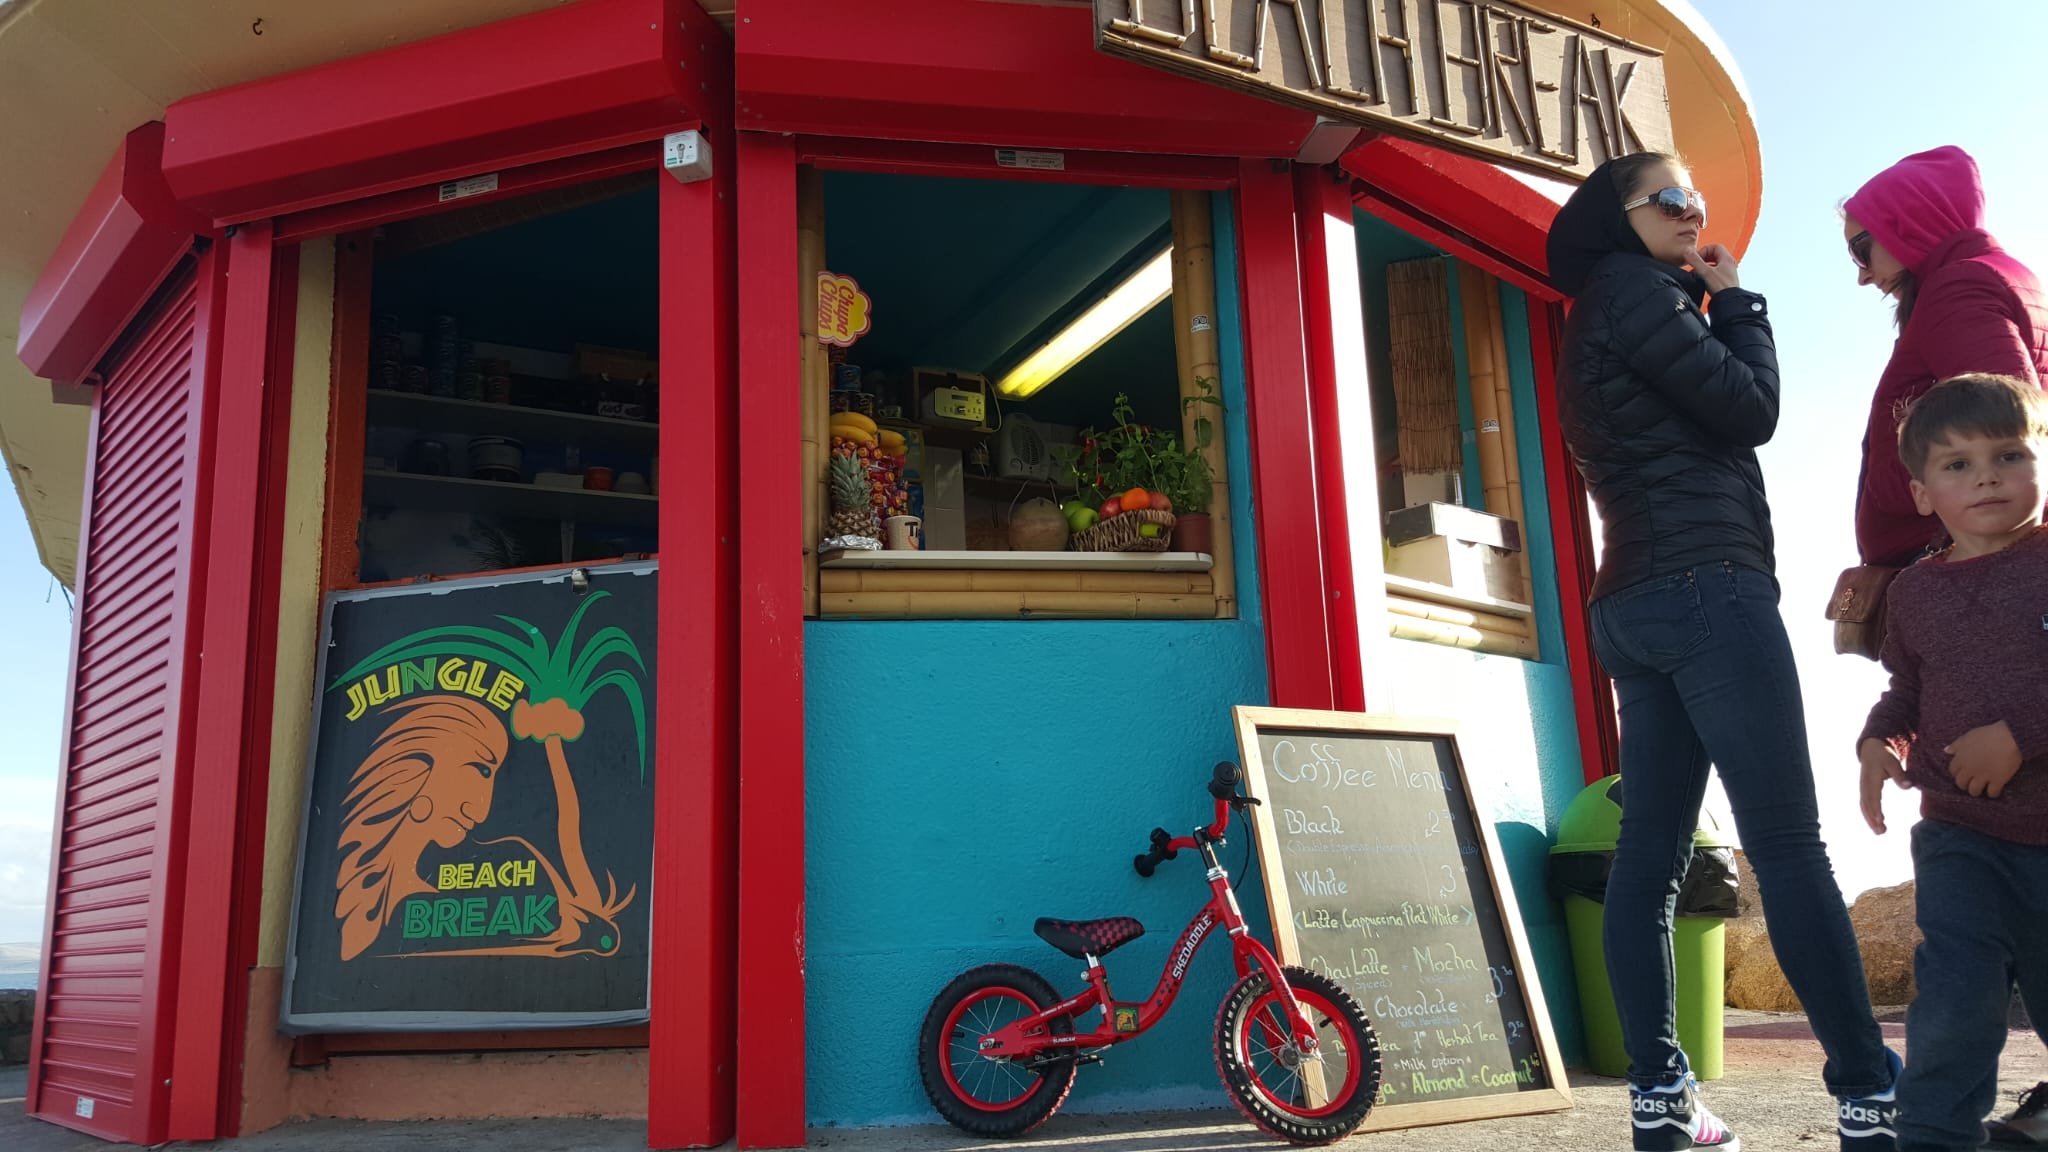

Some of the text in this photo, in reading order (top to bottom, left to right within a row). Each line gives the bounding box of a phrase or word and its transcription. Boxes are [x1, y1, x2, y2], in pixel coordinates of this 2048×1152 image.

[833, 285, 855, 337] Chupa
[345, 656, 525, 722] JUNGLE
[1272, 740, 1453, 792] Coffee Menu
[1282, 804, 1345, 836] Black
[437, 859, 536, 890] BEACH
[1294, 867, 1349, 897] White
[402, 894, 557, 939] BREAK
[1172, 915, 1213, 980] SKEDADDLE
[1412, 942, 1479, 974] Mocha
[1374, 988, 1458, 1018] Chocolate
[1473, 1020, 1499, 1042] Tea
[1411, 1066, 1469, 1095] Almond
[1480, 1057, 1537, 1088] Coconut
